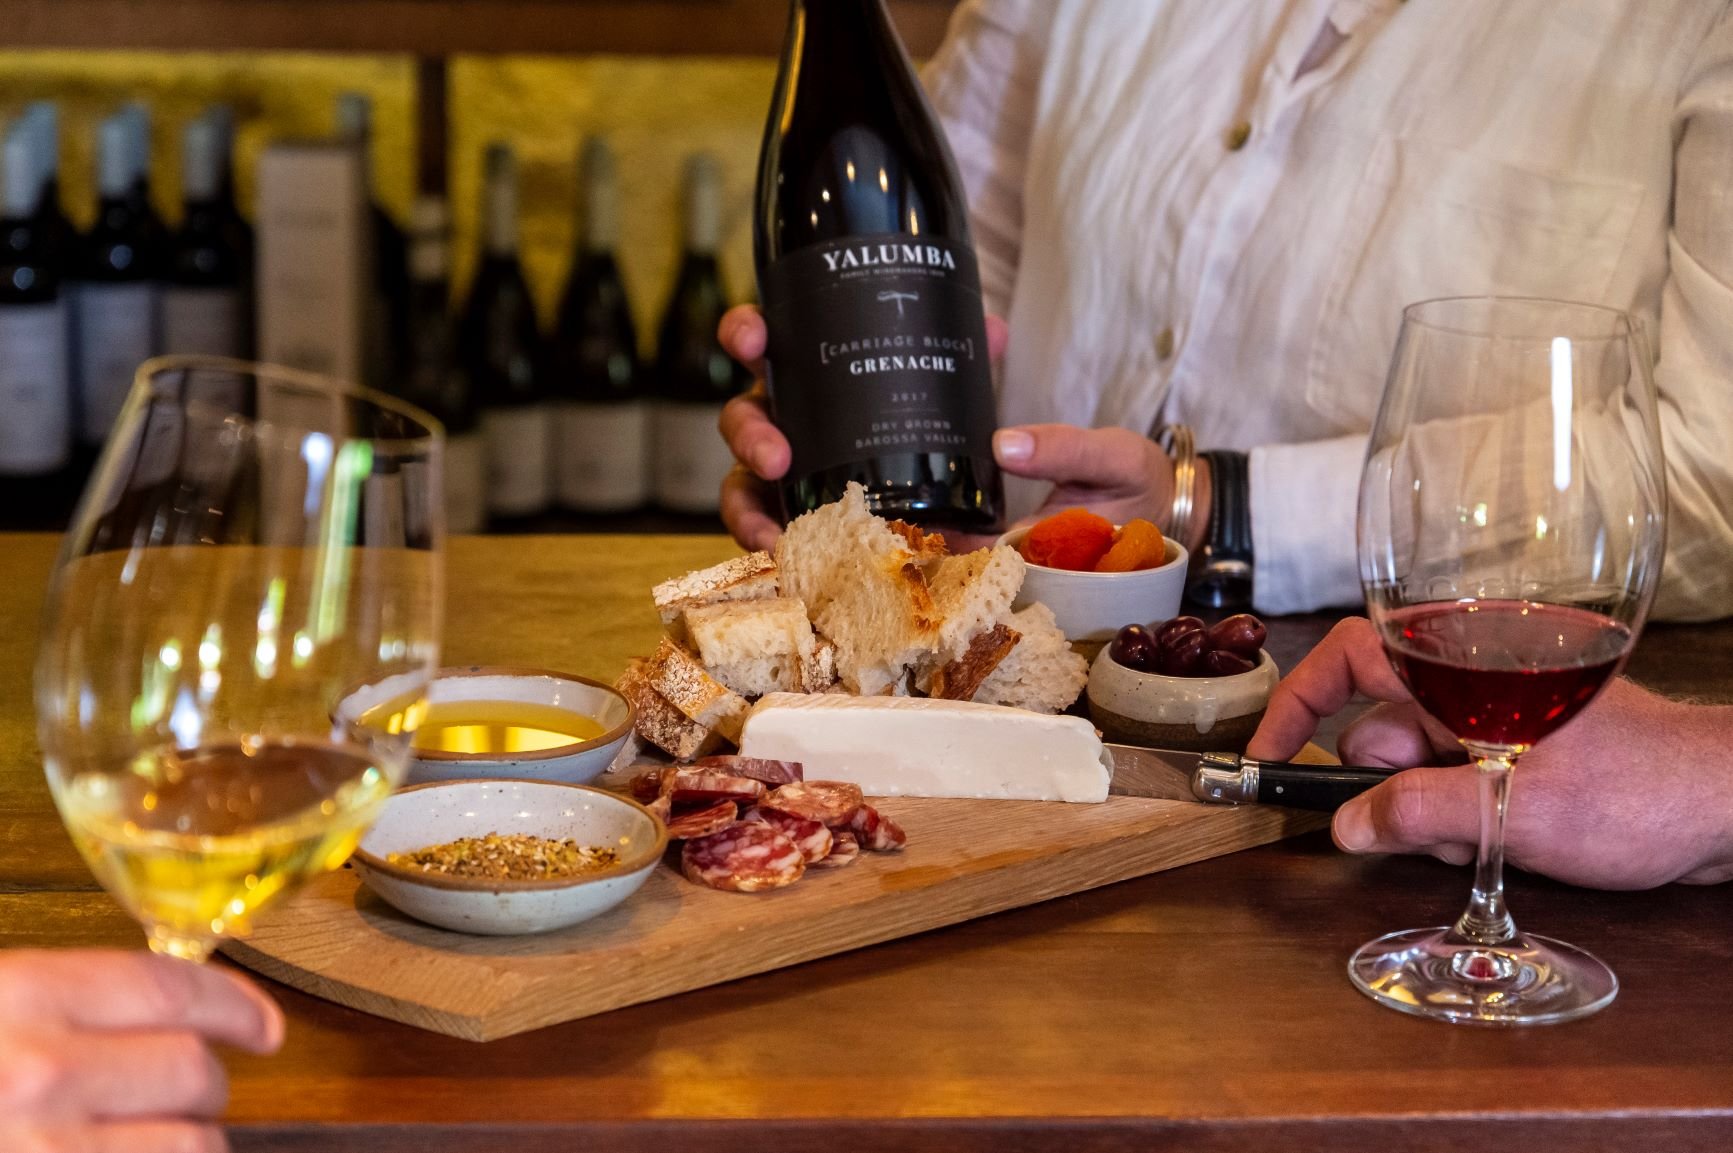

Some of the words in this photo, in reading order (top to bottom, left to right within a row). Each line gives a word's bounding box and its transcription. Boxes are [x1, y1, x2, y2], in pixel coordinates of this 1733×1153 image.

[822, 244, 956, 271] YALUMBA
[849, 355, 956, 375] GRENACHE
[872, 422, 897, 432] DRY
[905, 420, 951, 430] GROWN
[855, 434, 918, 448] BAROSSA
[925, 434, 966, 446] VALLEY
